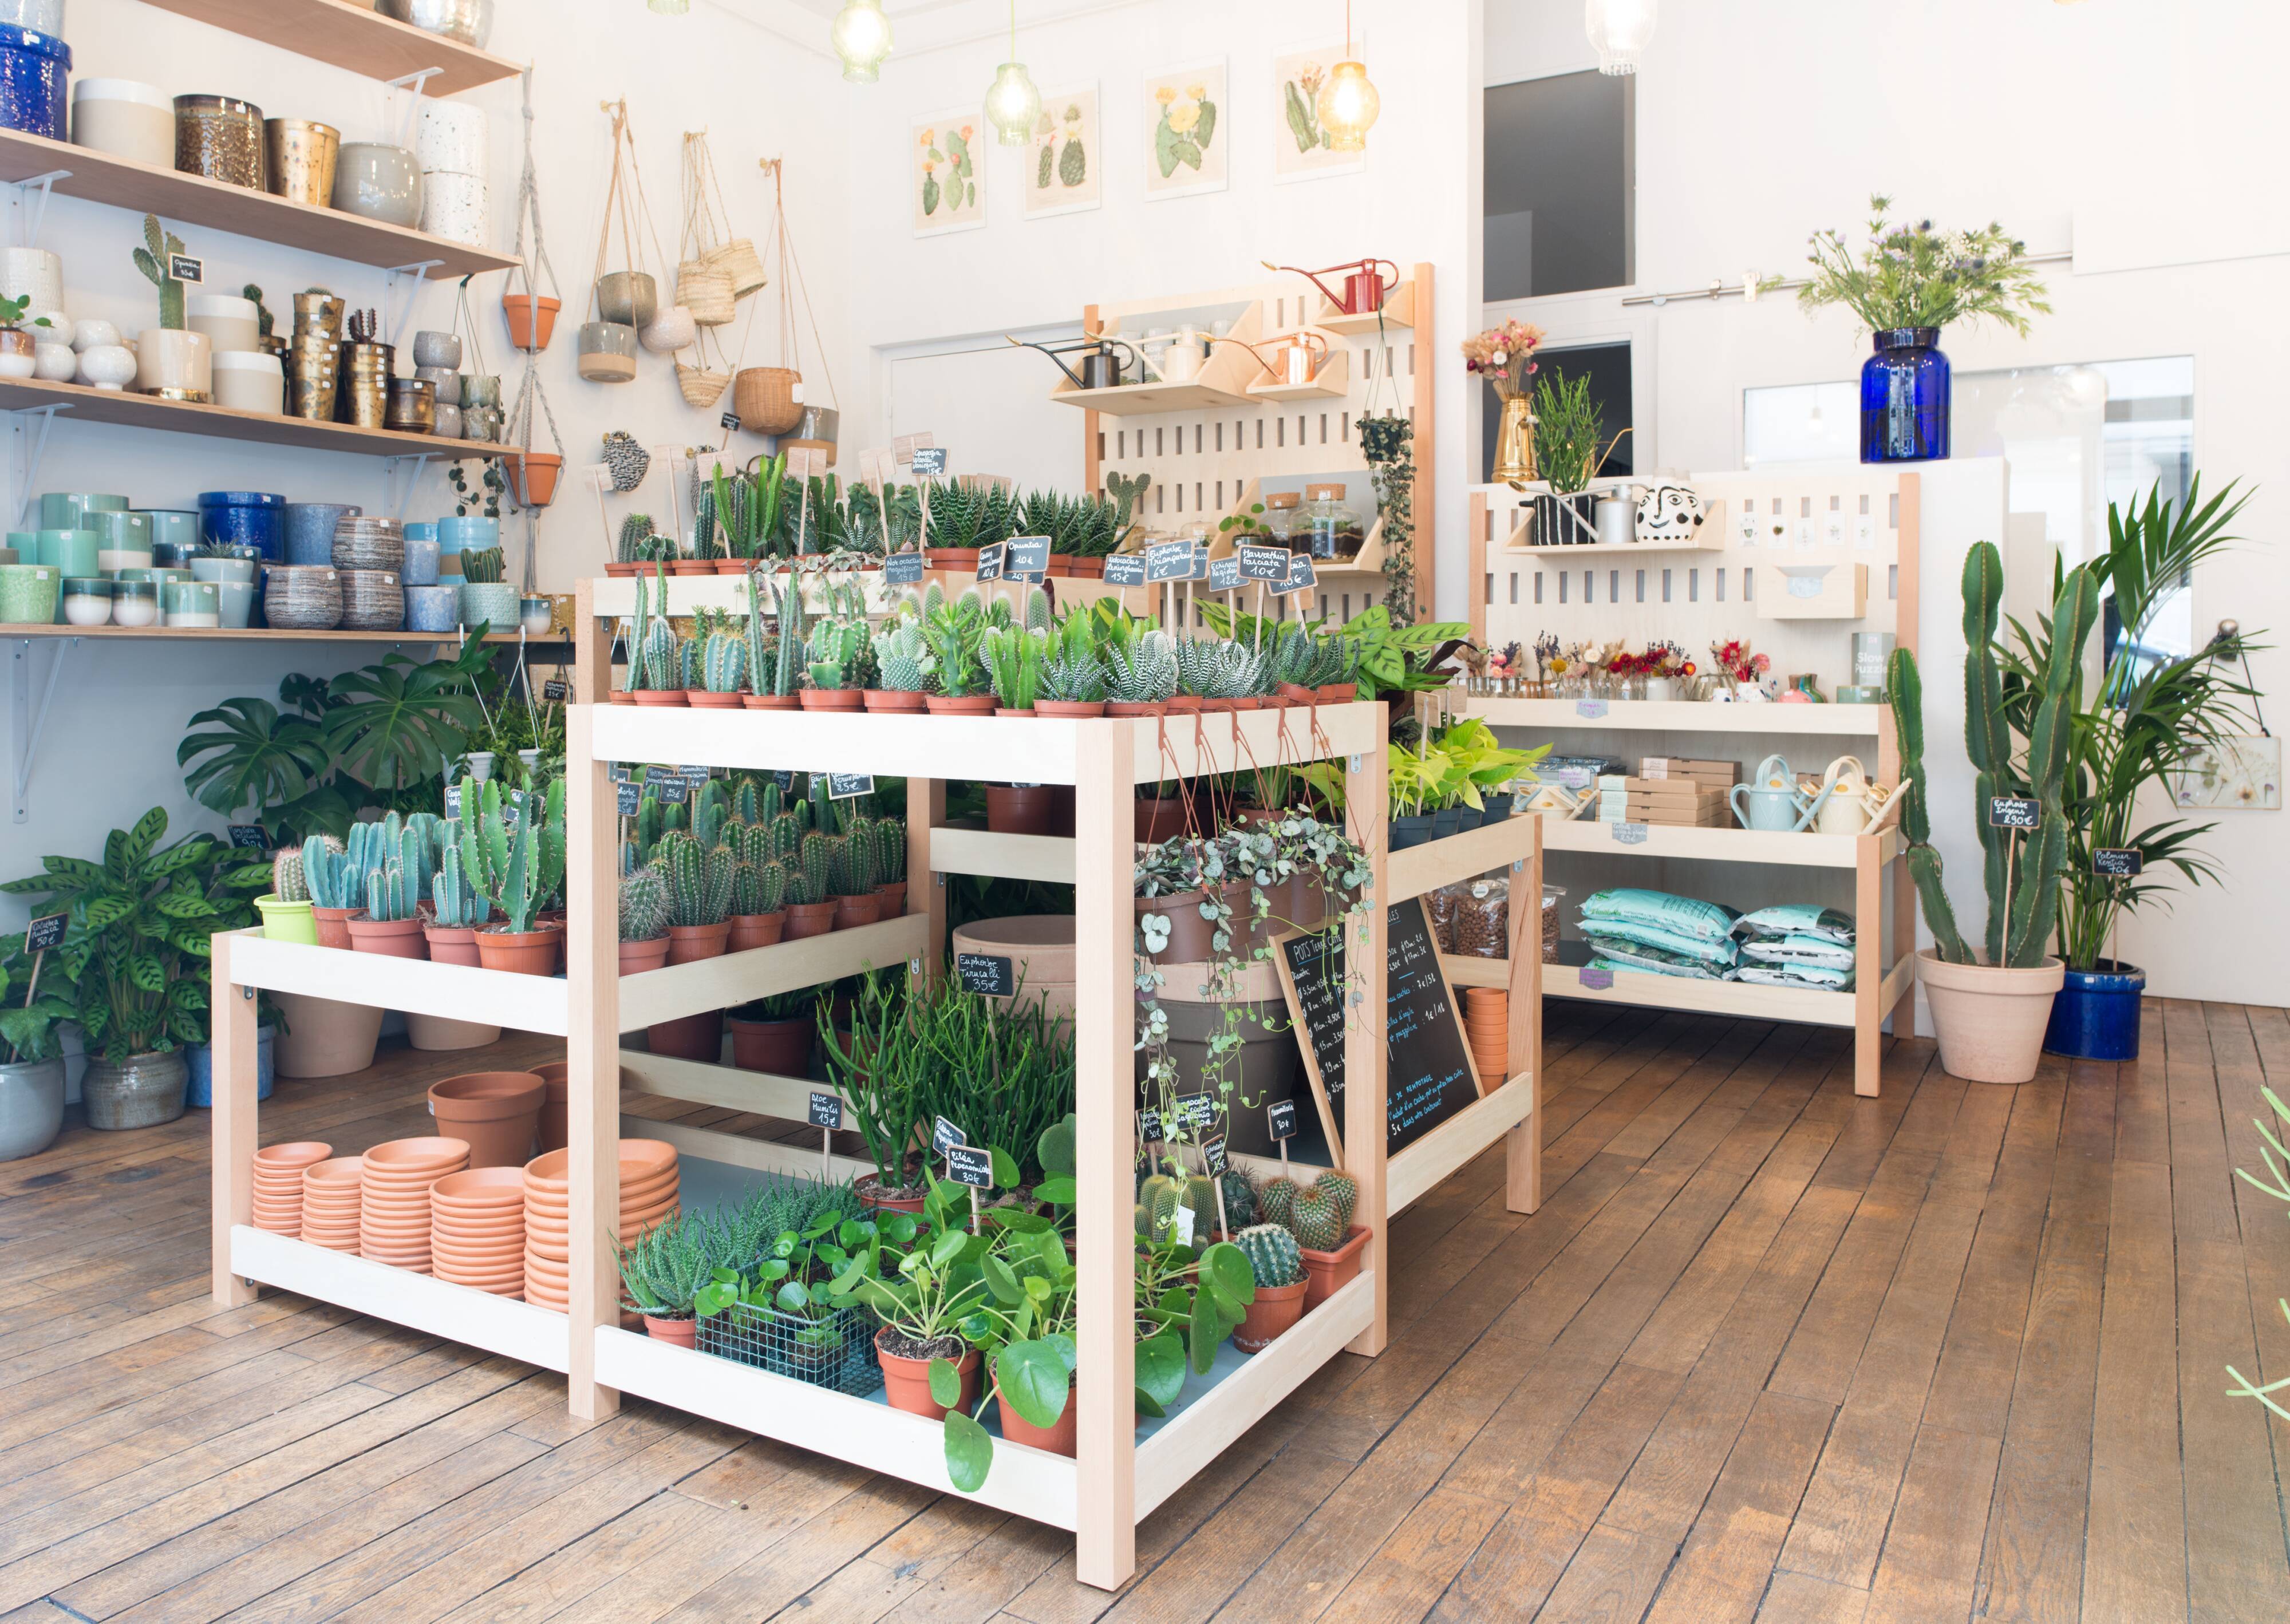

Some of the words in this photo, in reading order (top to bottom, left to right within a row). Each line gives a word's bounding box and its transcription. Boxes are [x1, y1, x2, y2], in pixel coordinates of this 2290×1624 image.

[1009, 538, 1043, 551] Opuntia
[1015, 555, 1033, 564] 10€
[1111, 572, 1130, 583] 15€
[1250, 566, 1276, 577] 10€
[1857, 652, 1885, 663] Slow
[1855, 663, 1888, 674] Puzzle
[2004, 815, 2034, 825] 290€
[2096, 851, 2131, 860] Palmier
[37, 934, 56, 947] 50€
[1294, 941, 1310, 962] POTS
[960, 955, 998, 968] Euphorbe
[973, 978, 998, 991] 35€
[1406, 1074, 1433, 1093] REMPOTAGE
[812, 1093, 828, 1104] Aloe
[818, 1112, 836, 1127] 15€
[962, 1172, 980, 1185] 30€
